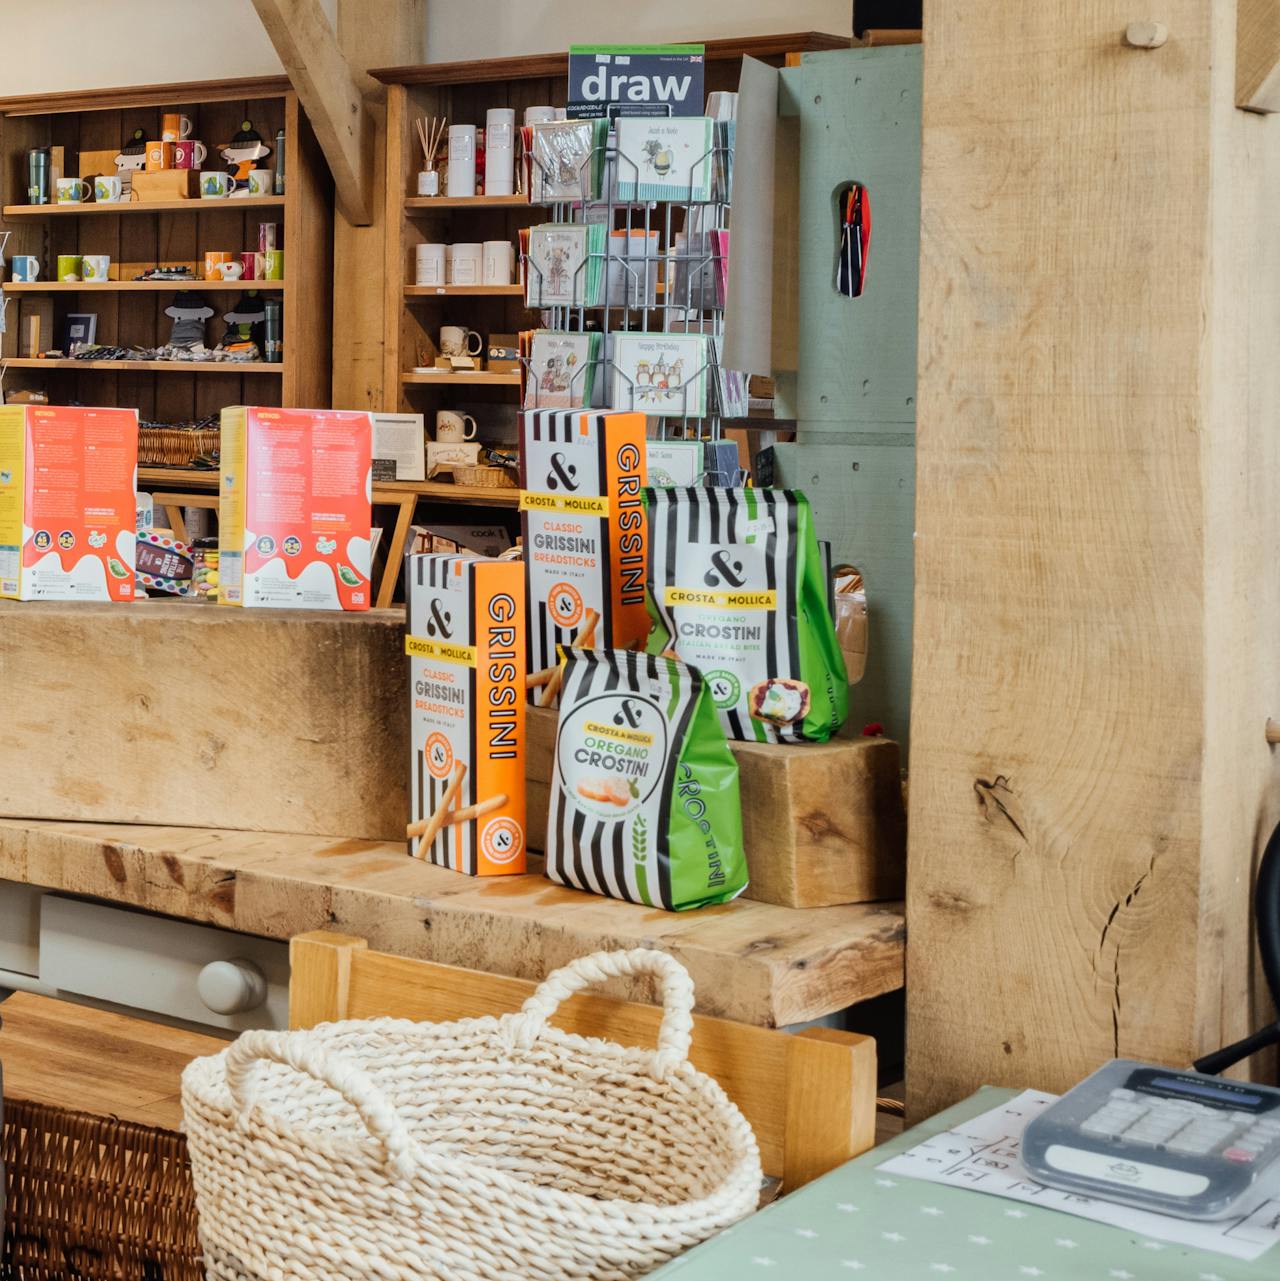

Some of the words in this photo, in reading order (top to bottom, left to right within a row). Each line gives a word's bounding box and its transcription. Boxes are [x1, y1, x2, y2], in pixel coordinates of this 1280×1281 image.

[582, 66, 692, 101] draw
[546, 452, 580, 491] &
[524, 495, 556, 507] CROSTA
[564, 498, 603, 511] MOLLICA
[543, 521, 583, 534] CLASSIC
[616, 443, 645, 606] GRISSINI
[533, 533, 596, 554] GRISSINI
[533, 553, 596, 568] BREADSTICKS
[704, 549, 747, 588] &
[670, 591, 715, 604] CROSTA
[727, 593, 772, 605] MOLLICA
[426, 598, 454, 639] &
[698, 614, 746, 623] OREGANO
[680, 622, 761, 641] CROSTINI
[408, 640, 434, 654] CROSTA
[440, 646, 472, 661] MOLLICA
[423, 668, 454, 683] CLASSIC
[488, 592, 518, 760] GRISSINI
[415, 679, 465, 705] GRISSINI
[415, 699, 465, 718] BREADSTICKS
[613, 699, 643, 729] &
[586, 722, 620, 736] CROSTA
[584, 736, 649, 759] OREGANO
[574, 747, 648, 778] CROSTINI
[678, 760, 727, 888] CROSTINI
